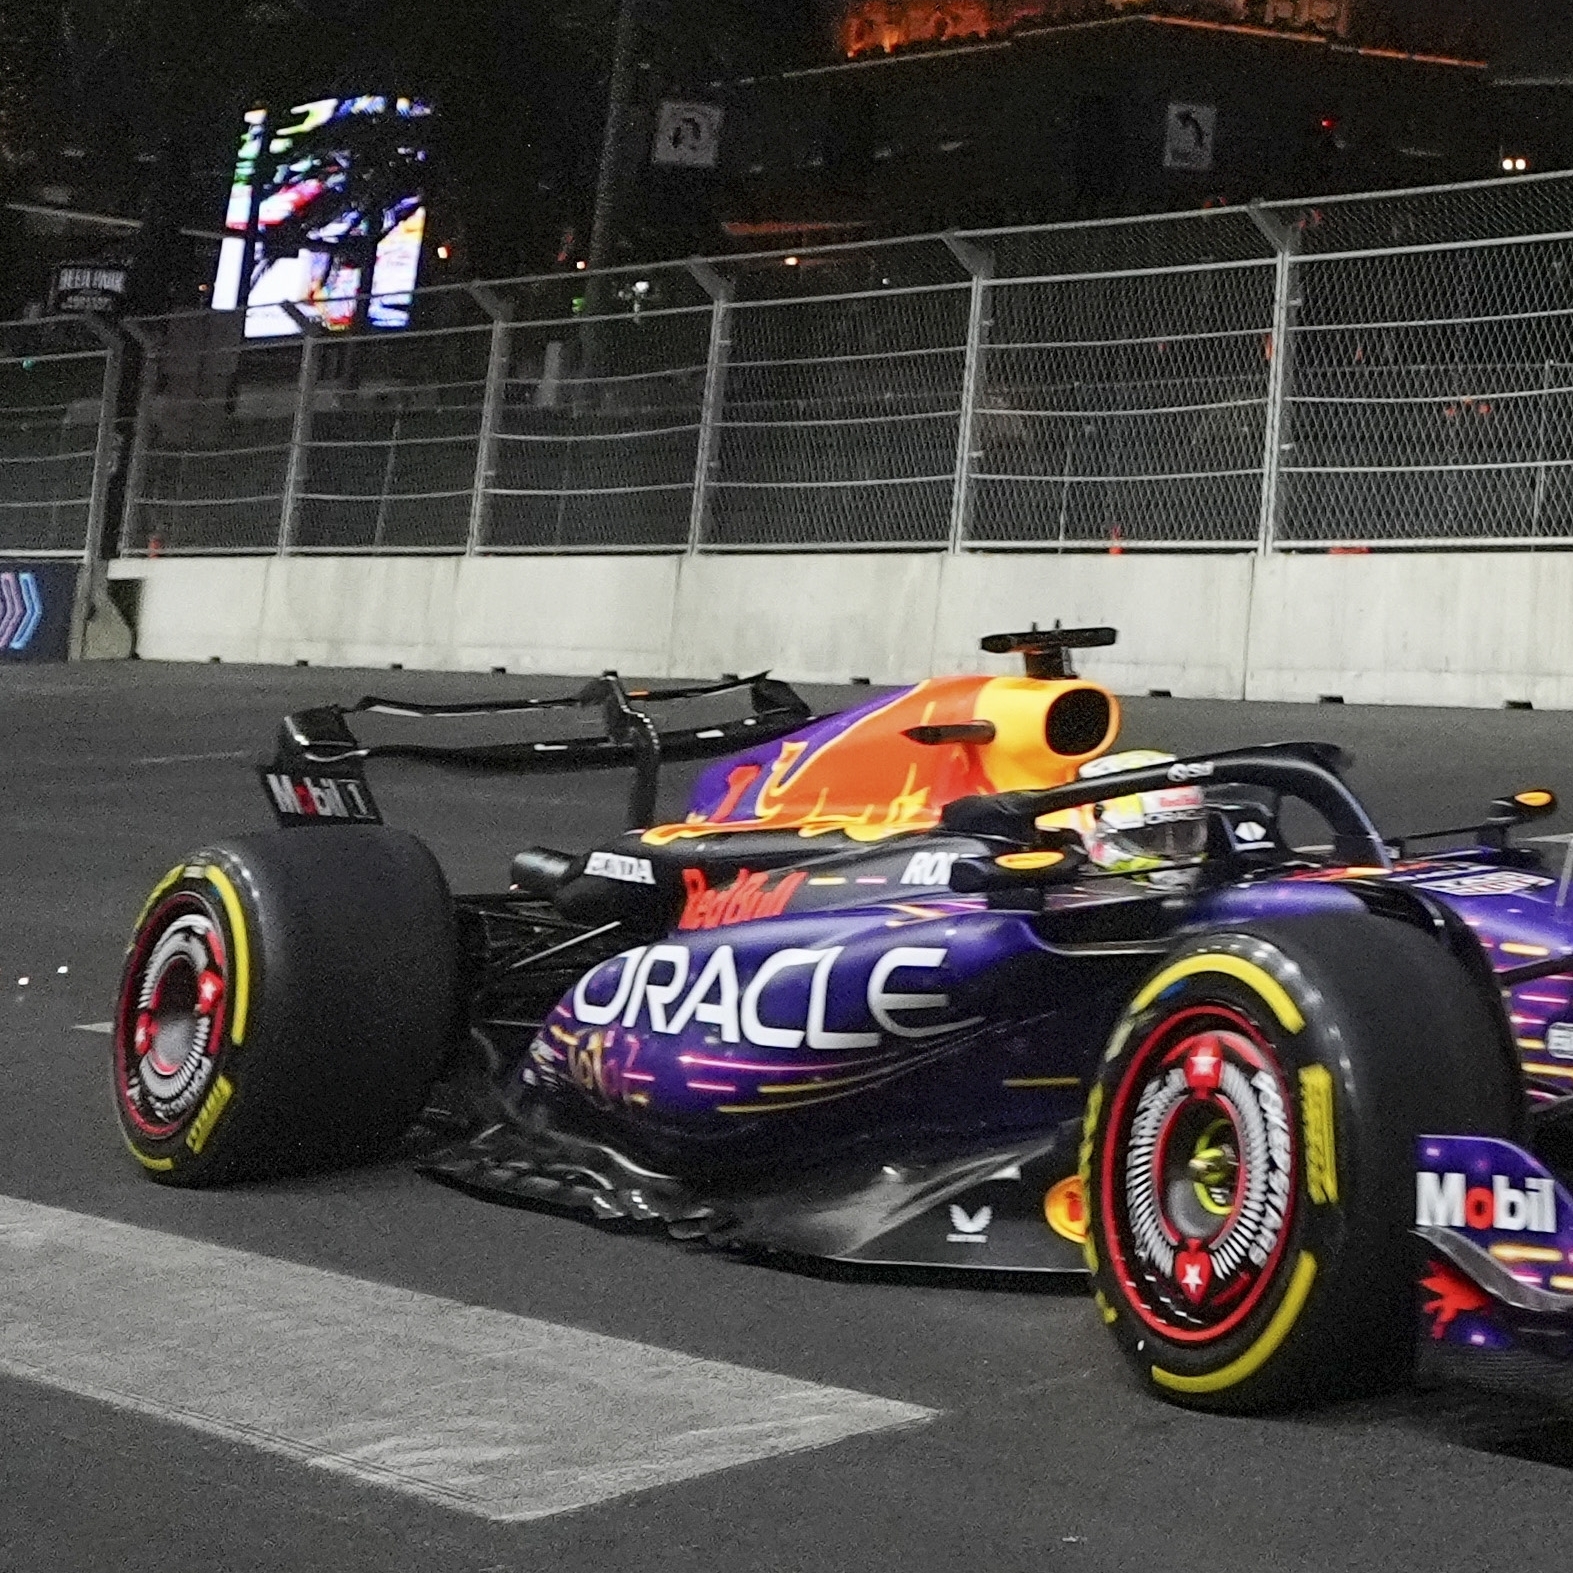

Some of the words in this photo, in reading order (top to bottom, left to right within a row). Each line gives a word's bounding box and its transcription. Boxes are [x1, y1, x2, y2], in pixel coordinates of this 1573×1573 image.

[266, 773, 350, 818] Mobil
[573, 944, 984, 1050] ORACLE
[1416, 1172, 1557, 1233] Mobil
